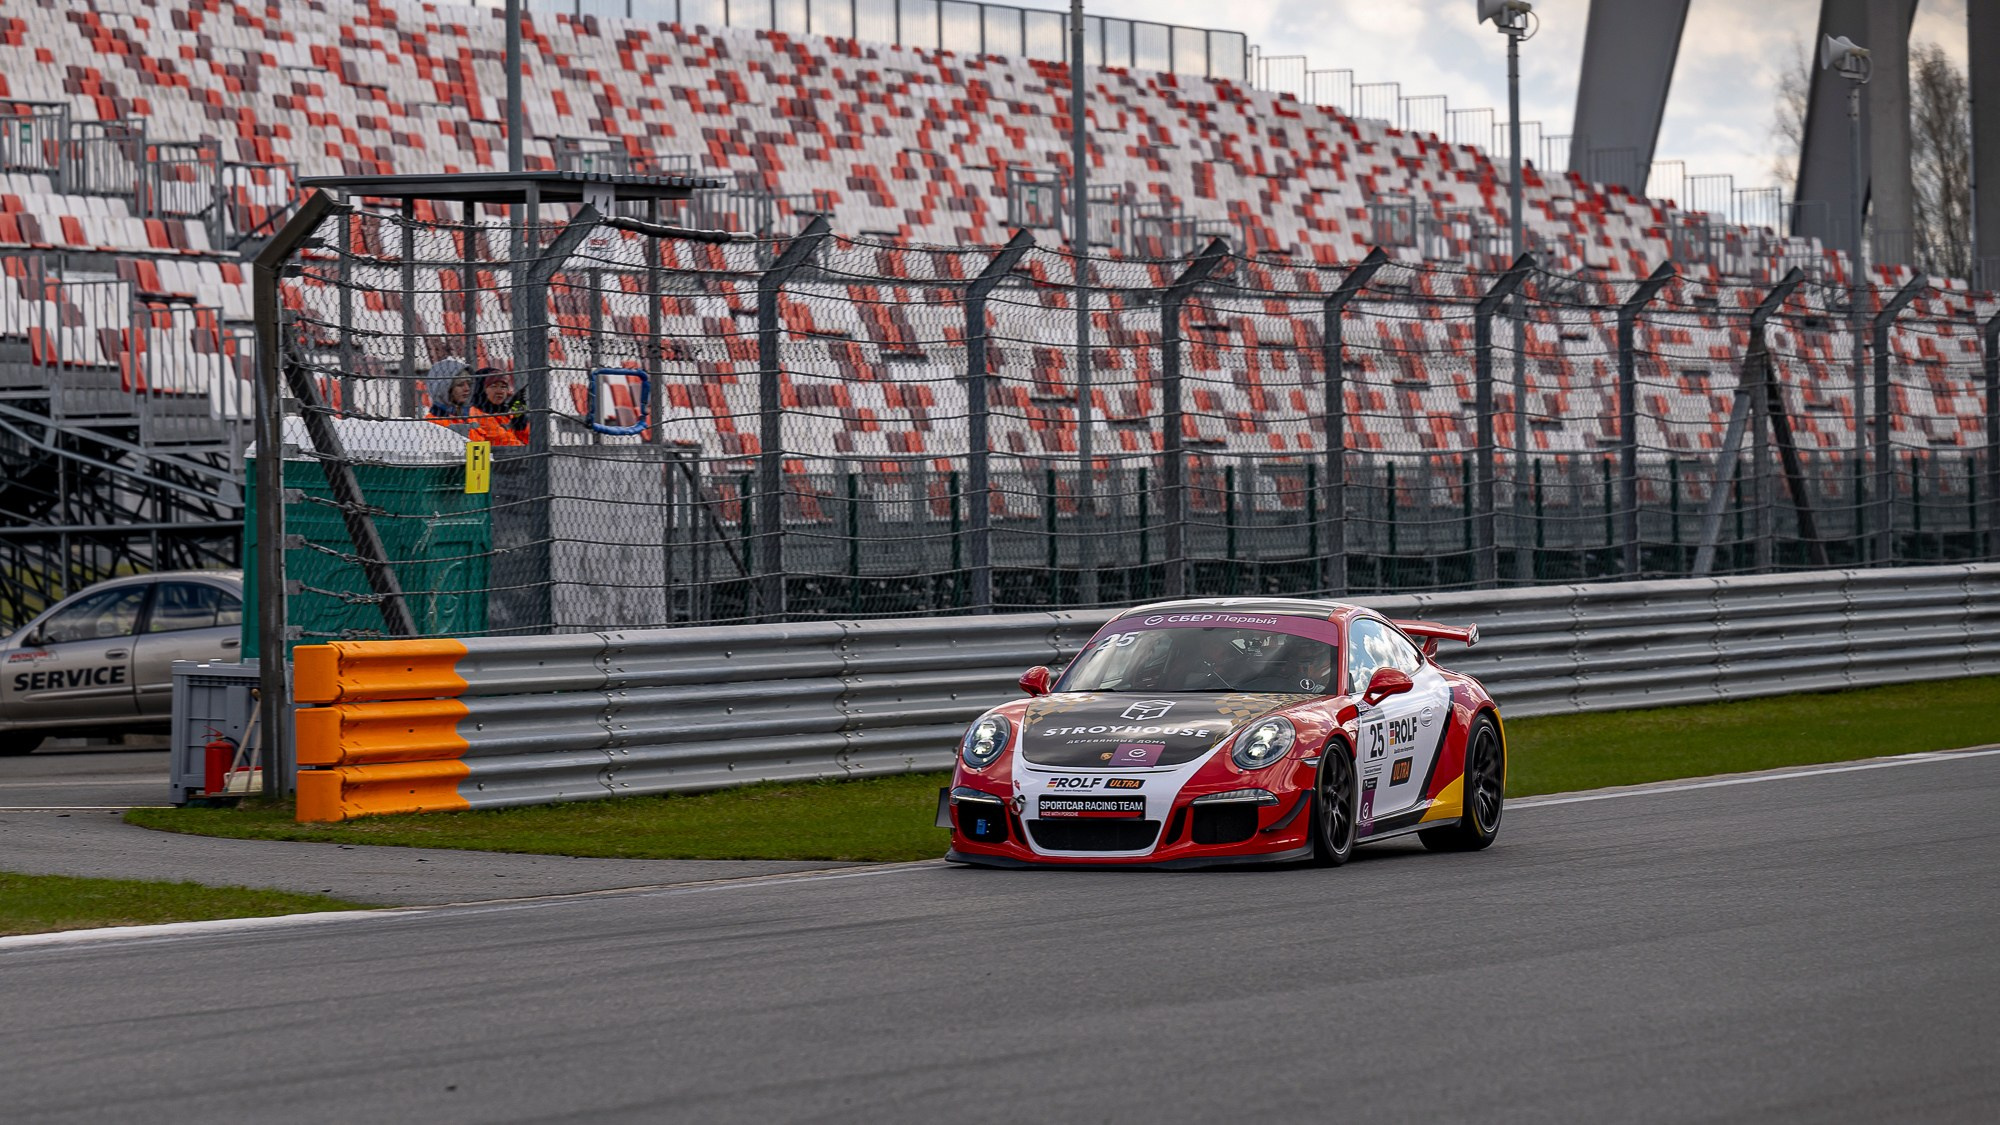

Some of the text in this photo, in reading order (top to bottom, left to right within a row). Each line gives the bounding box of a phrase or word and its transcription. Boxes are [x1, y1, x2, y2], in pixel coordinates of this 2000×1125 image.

[472, 445, 486, 471] F1
[1167, 614, 1278, 625] СБЕР Первый
[1097, 631, 1140, 651] 25
[13, 666, 125, 691] SERVICE
[1043, 725, 1209, 738] STROYHOUSE
[1370, 723, 1385, 758] 25
[1394, 717, 1417, 744] ROLF
[1393, 761, 1410, 781] ULTRA
[1056, 778, 1140, 788] ROLF ULTRA
[1040, 801, 1143, 810] SPORTCAR RACING TEAM
